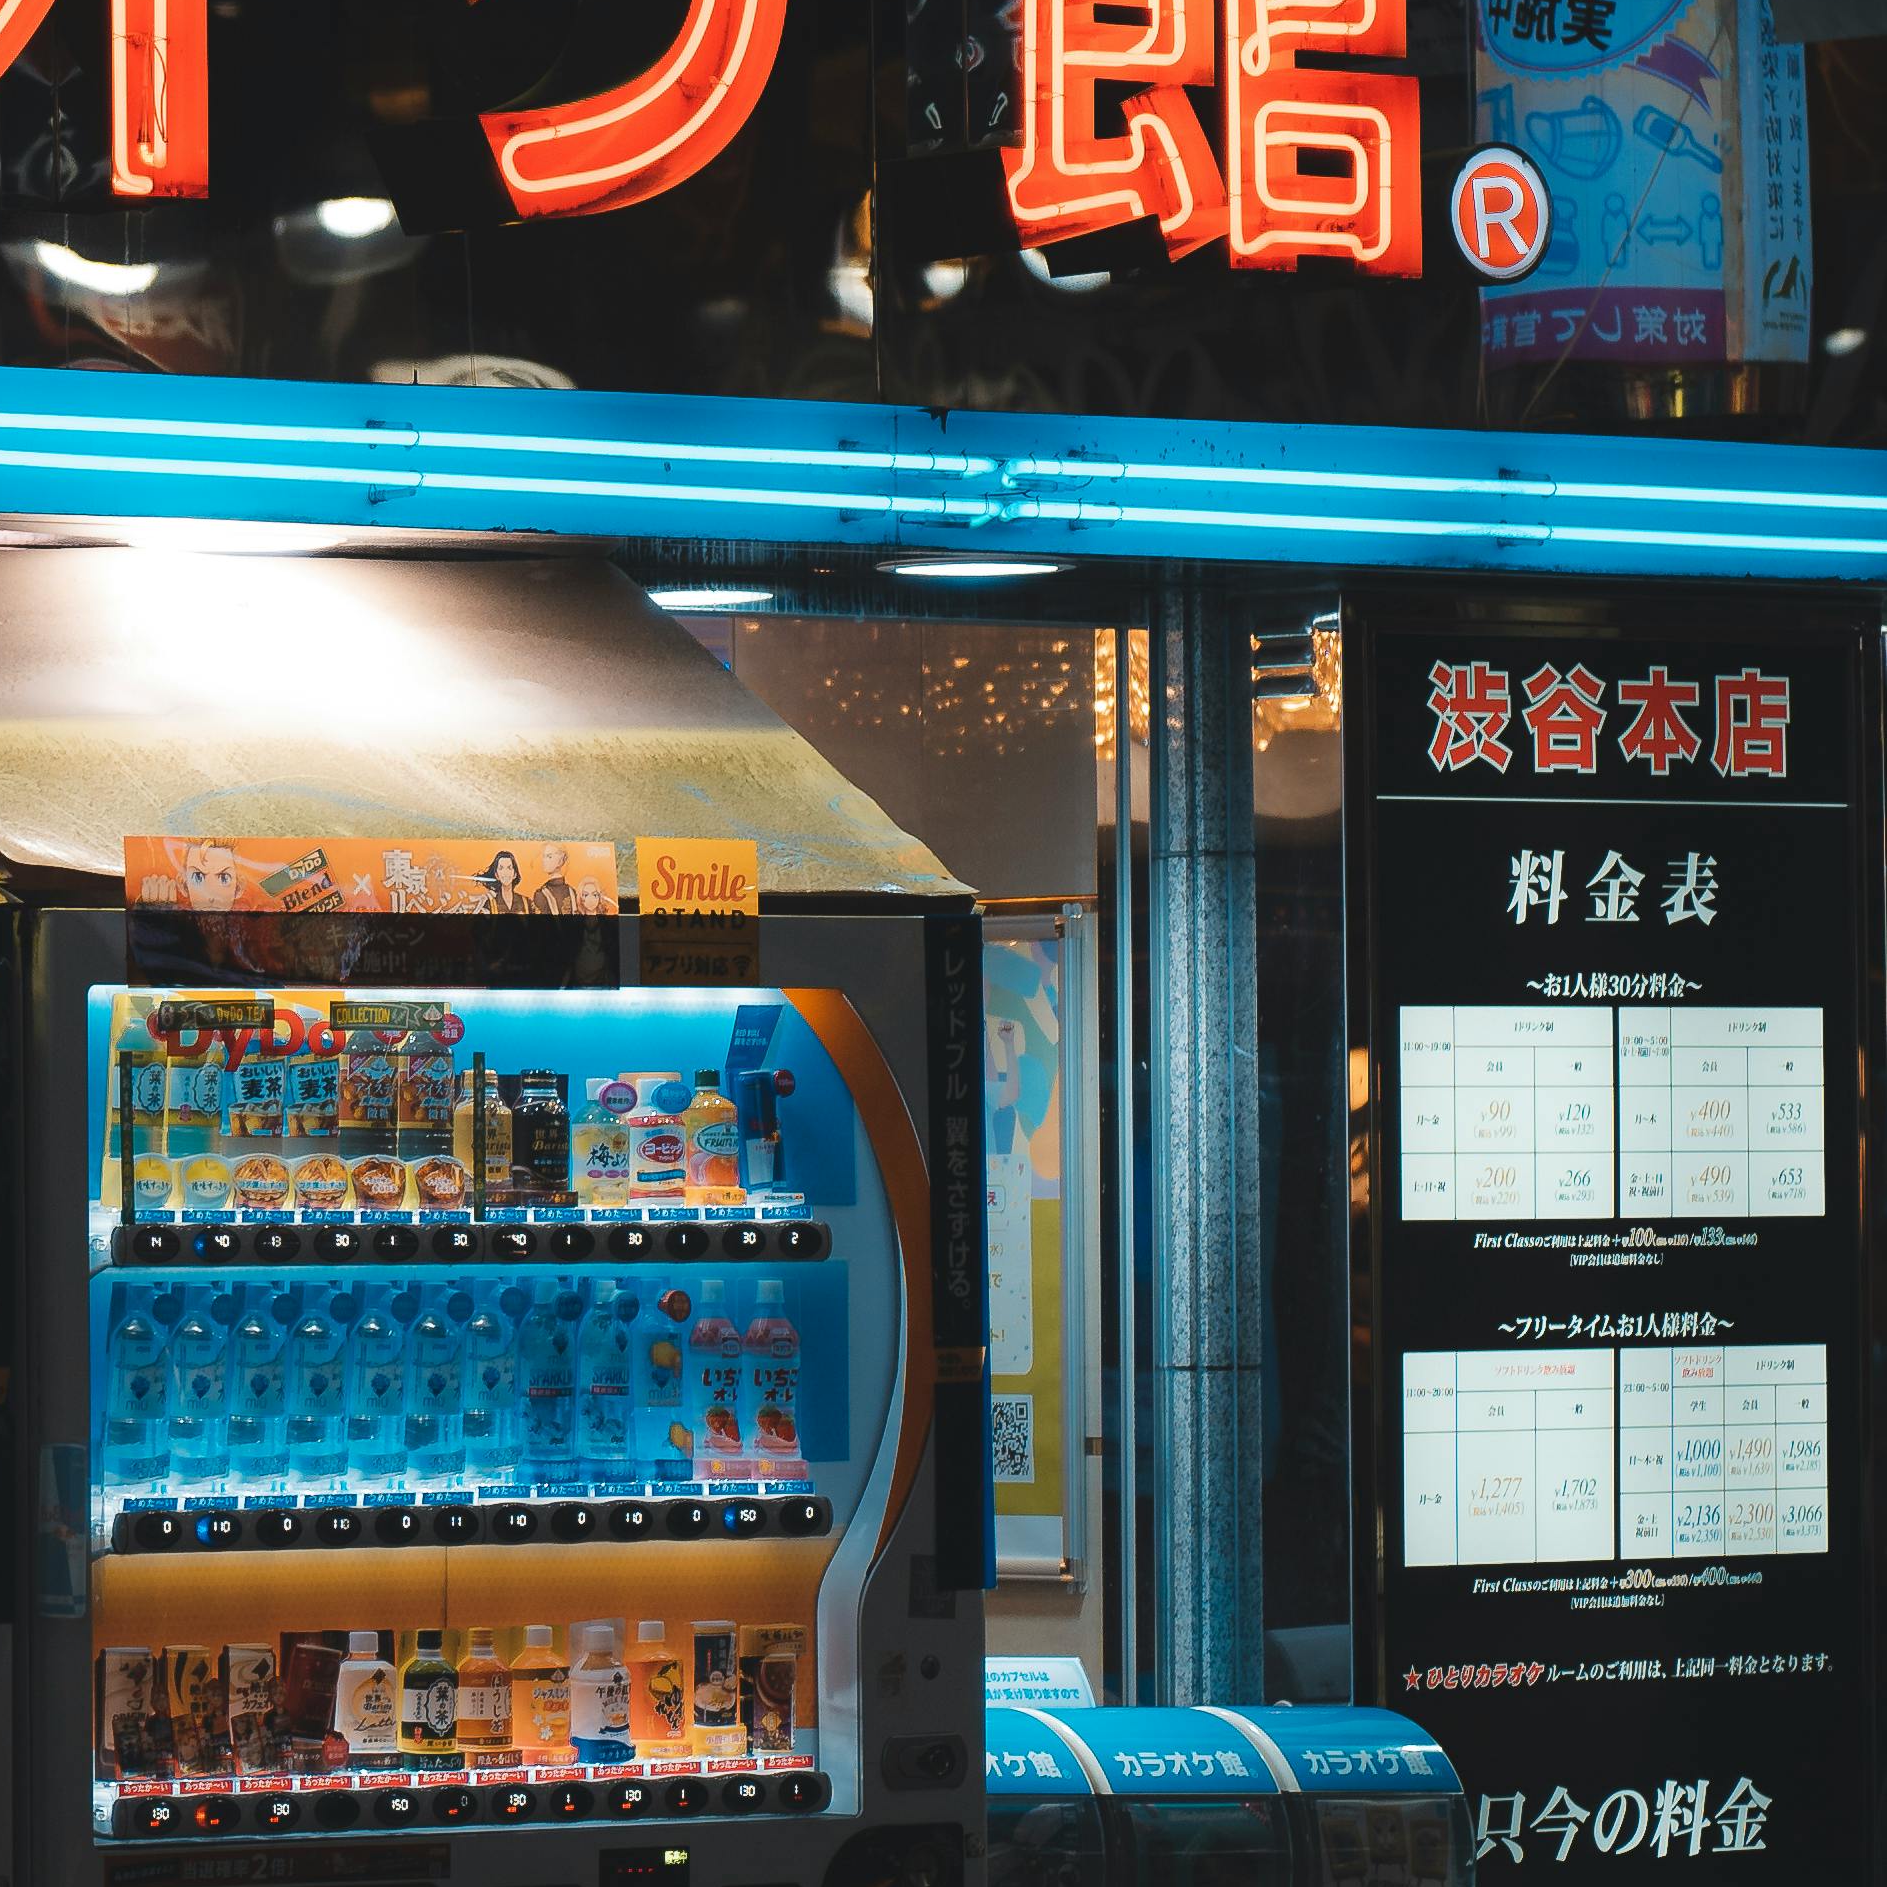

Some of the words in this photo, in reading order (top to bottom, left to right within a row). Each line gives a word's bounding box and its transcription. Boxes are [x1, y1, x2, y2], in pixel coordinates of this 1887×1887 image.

[1428, 659, 1791, 778] 渋谷本店
[289, 856, 322, 879] DyDo
[652, 856, 747, 902] Smile
[1507, 849, 1721, 925] 料金表
[284, 873, 333, 908] Blend
[654, 908, 746, 930] STAND
[648, 953, 728, 976] アプリ対応
[245, 1007, 266, 1022] TEA
[335, 1006, 391, 1025] COLLECTION
[944, 949, 969, 1102] レッドブル
[240, 1064, 283, 1077] おいしい
[296, 1063, 338, 1078] おいしい
[240, 1075, 284, 1100] 麦茶
[298, 1075, 338, 1101] 麦茶
[1481, 1099, 1511, 1122] ¥90
[1559, 1102, 1591, 1122] ¥120
[1690, 1099, 1731, 1122] ¥400
[1771, 1102, 1803, 1121] ¥533
[1475, 1166, 1516, 1188] ¥200
[1559, 1170, 1591, 1188] ¥266
[1690, 1165, 1732, 1187] ¥490
[1771, 1167, 1803, 1186] ¥653
[944, 1116, 971, 1310] 翼をさずける。
[1474, 1233, 1503, 1248] First
[1677, 1439, 1721, 1461] ¥1,000
[1729, 1438, 1772, 1460] ¥1,490
[1782, 1439, 1822, 1459] ¥1,986
[1471, 1477, 1524, 1502] ¥1,277
[1555, 1478, 1597, 1499] ¥1,702
[1677, 1505, 1721, 1527] ¥2,136
[1728, 1502, 1775, 1526] ¥2,300
[1782, 1505, 1823, 1524] ¥3,066
[1473, 1578, 1501, 1594] First
[1426, 1662, 1545, 1691] ひとりカラオケ
[435, 1685, 450, 1727] 葉の茶
[598, 1765, 641, 1776] あったか〜い
[769, 1756, 810, 1768] あったか〜い
[1114, 1751, 1251, 1778] カラオケ館
[1301, 1749, 1436, 1777] カラオケ館
[124, 1783, 169, 1794] あったか〜い
[245, 1779, 289, 1790] あったか〜い
[1466, 1776, 1774, 1865] 只今の料金
